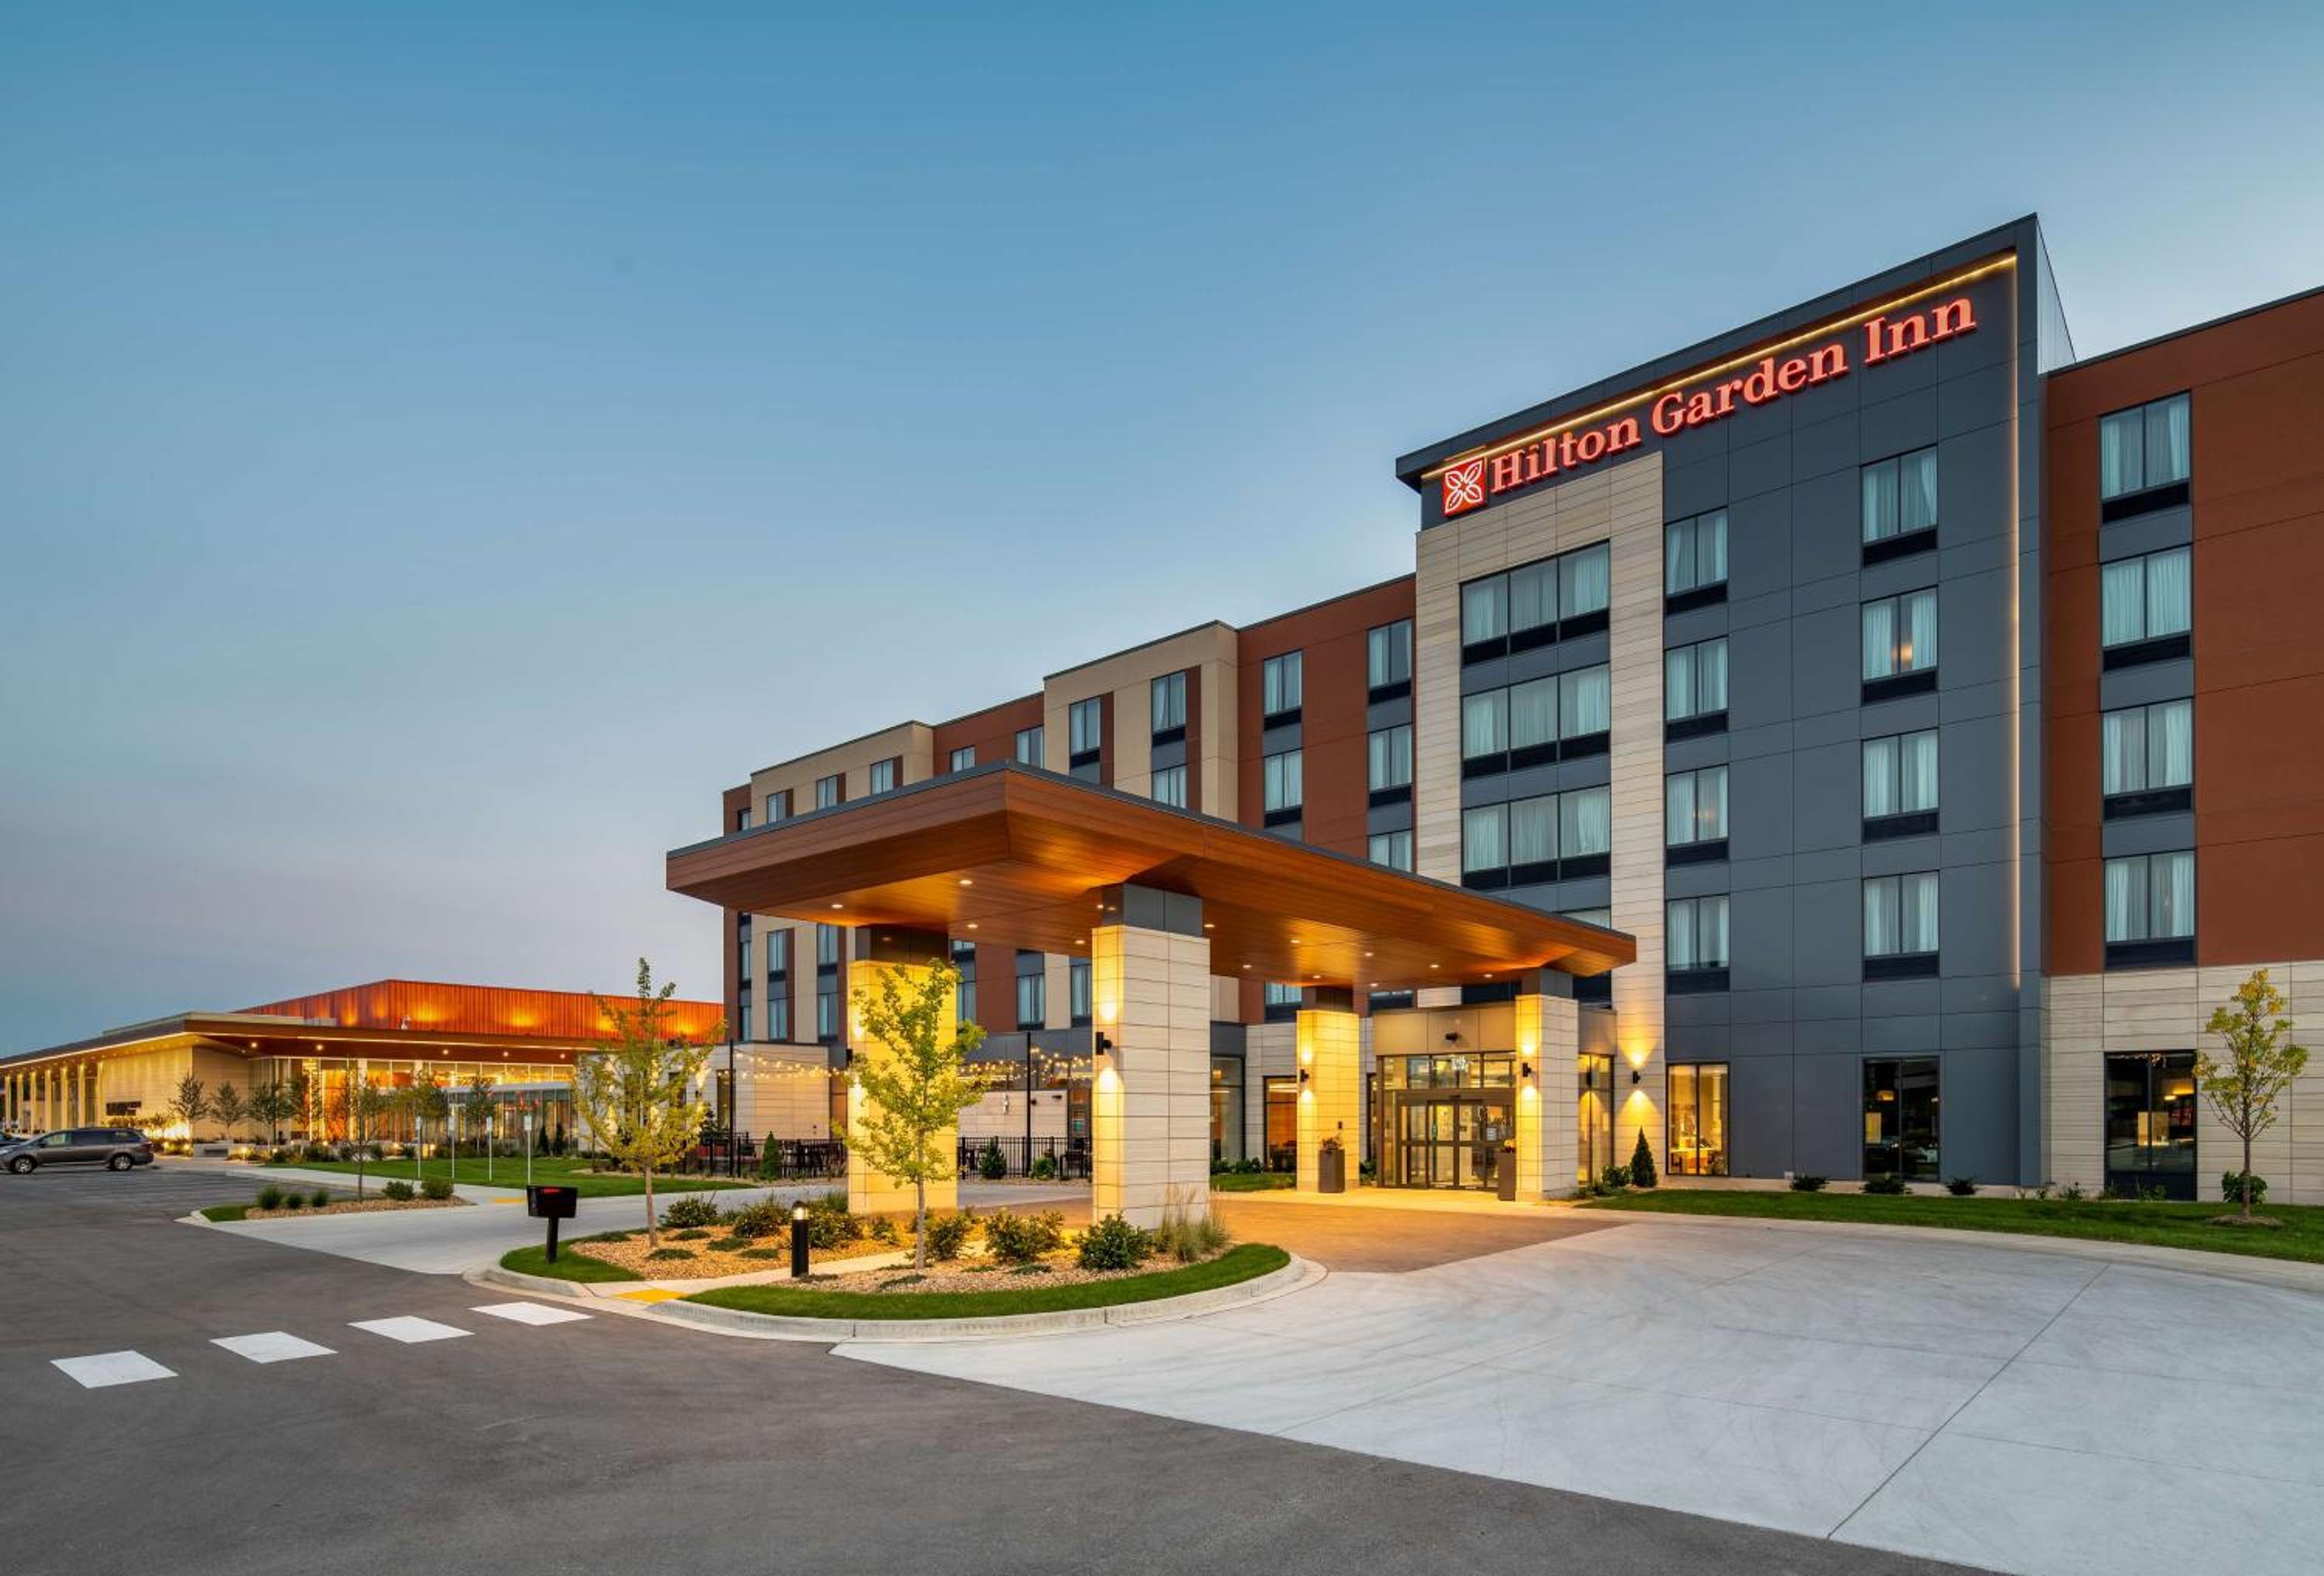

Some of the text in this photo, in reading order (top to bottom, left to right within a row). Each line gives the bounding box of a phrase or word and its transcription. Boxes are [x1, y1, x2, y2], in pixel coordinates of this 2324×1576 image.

[1490, 298, 1977, 494] Hilton Garden Inn
